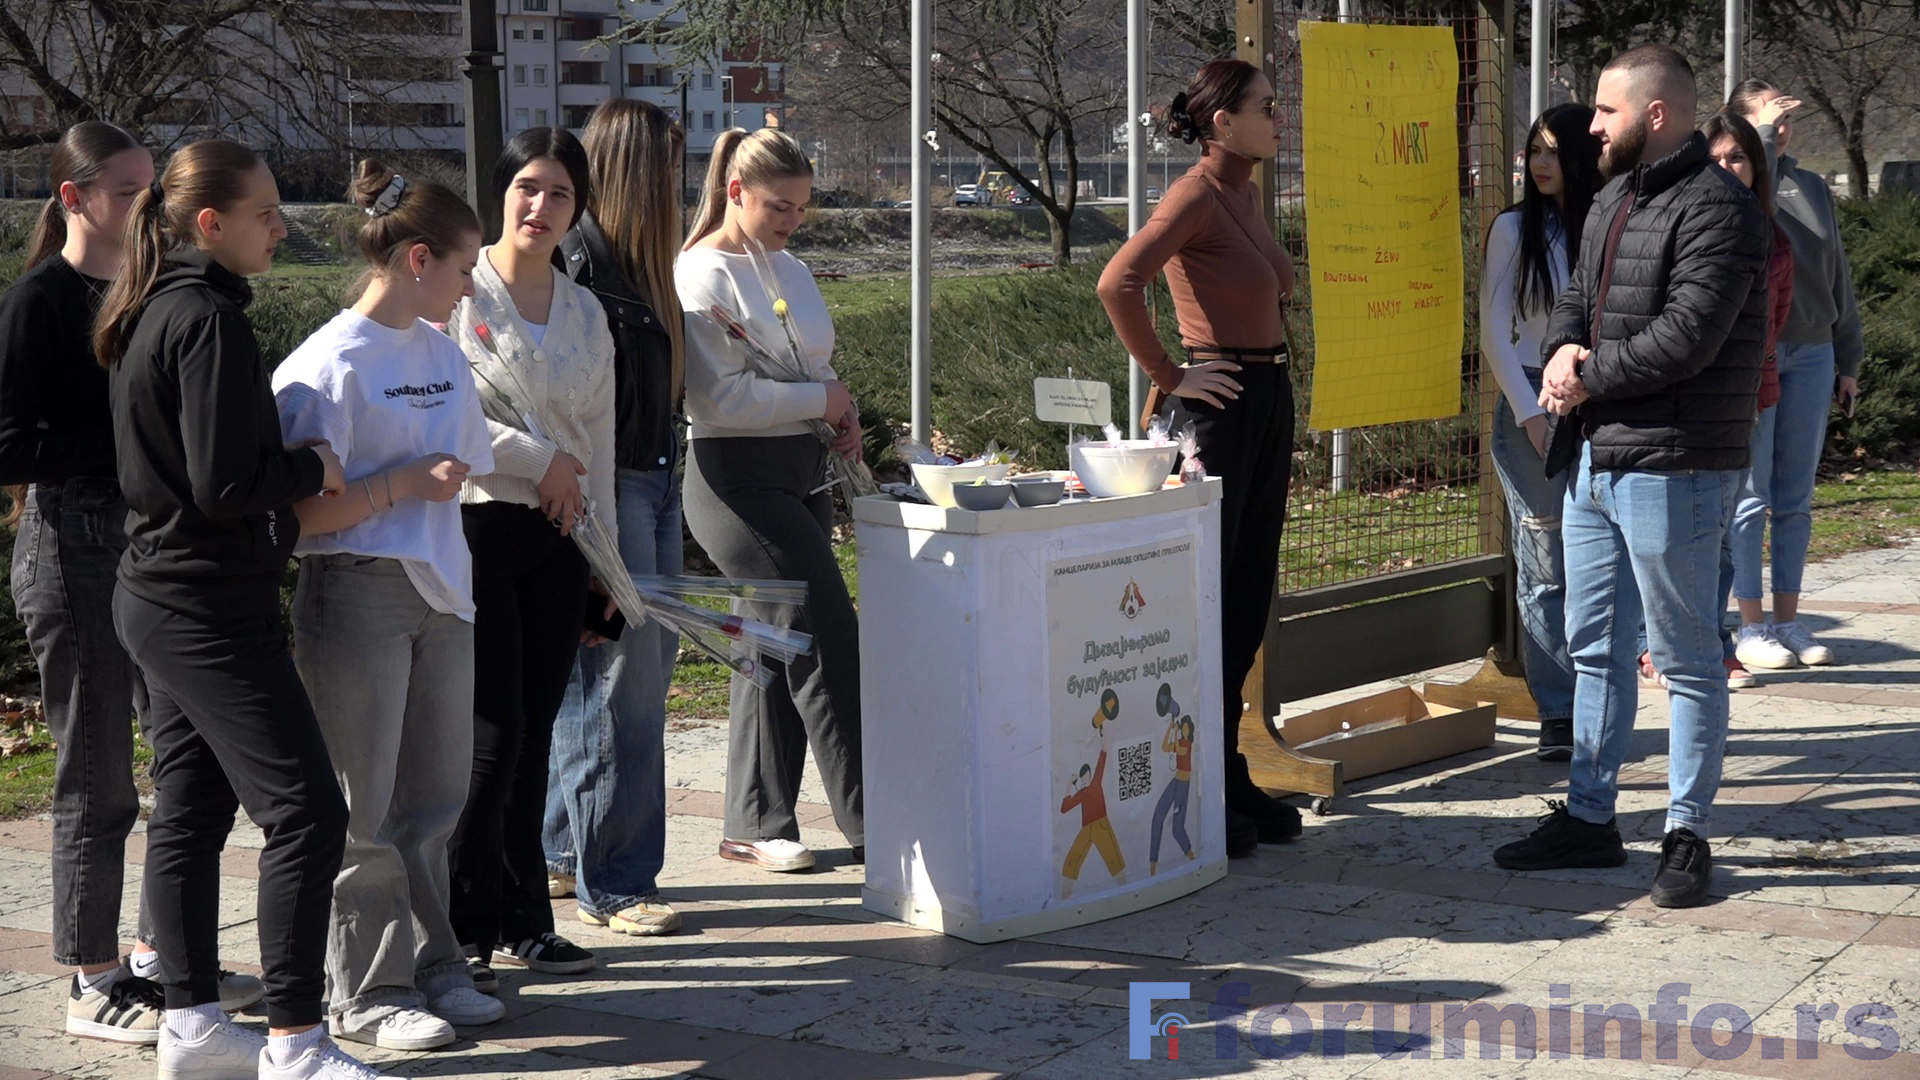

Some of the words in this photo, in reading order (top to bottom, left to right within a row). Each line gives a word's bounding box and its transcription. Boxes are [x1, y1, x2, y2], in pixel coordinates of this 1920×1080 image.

[1392, 121, 1430, 165] MART
[426, 380, 454, 395] Club
[1053, 563, 1100, 576] КАНЦЕЛАРИЈА
[1102, 560, 1110, 569] ЗА
[1110, 554, 1133, 566] МЛАДЕ
[1083, 628, 1170, 664] Дизајнирамо
[1067, 666, 1138, 698] будућност
[1142, 653, 1189, 680] заједно
